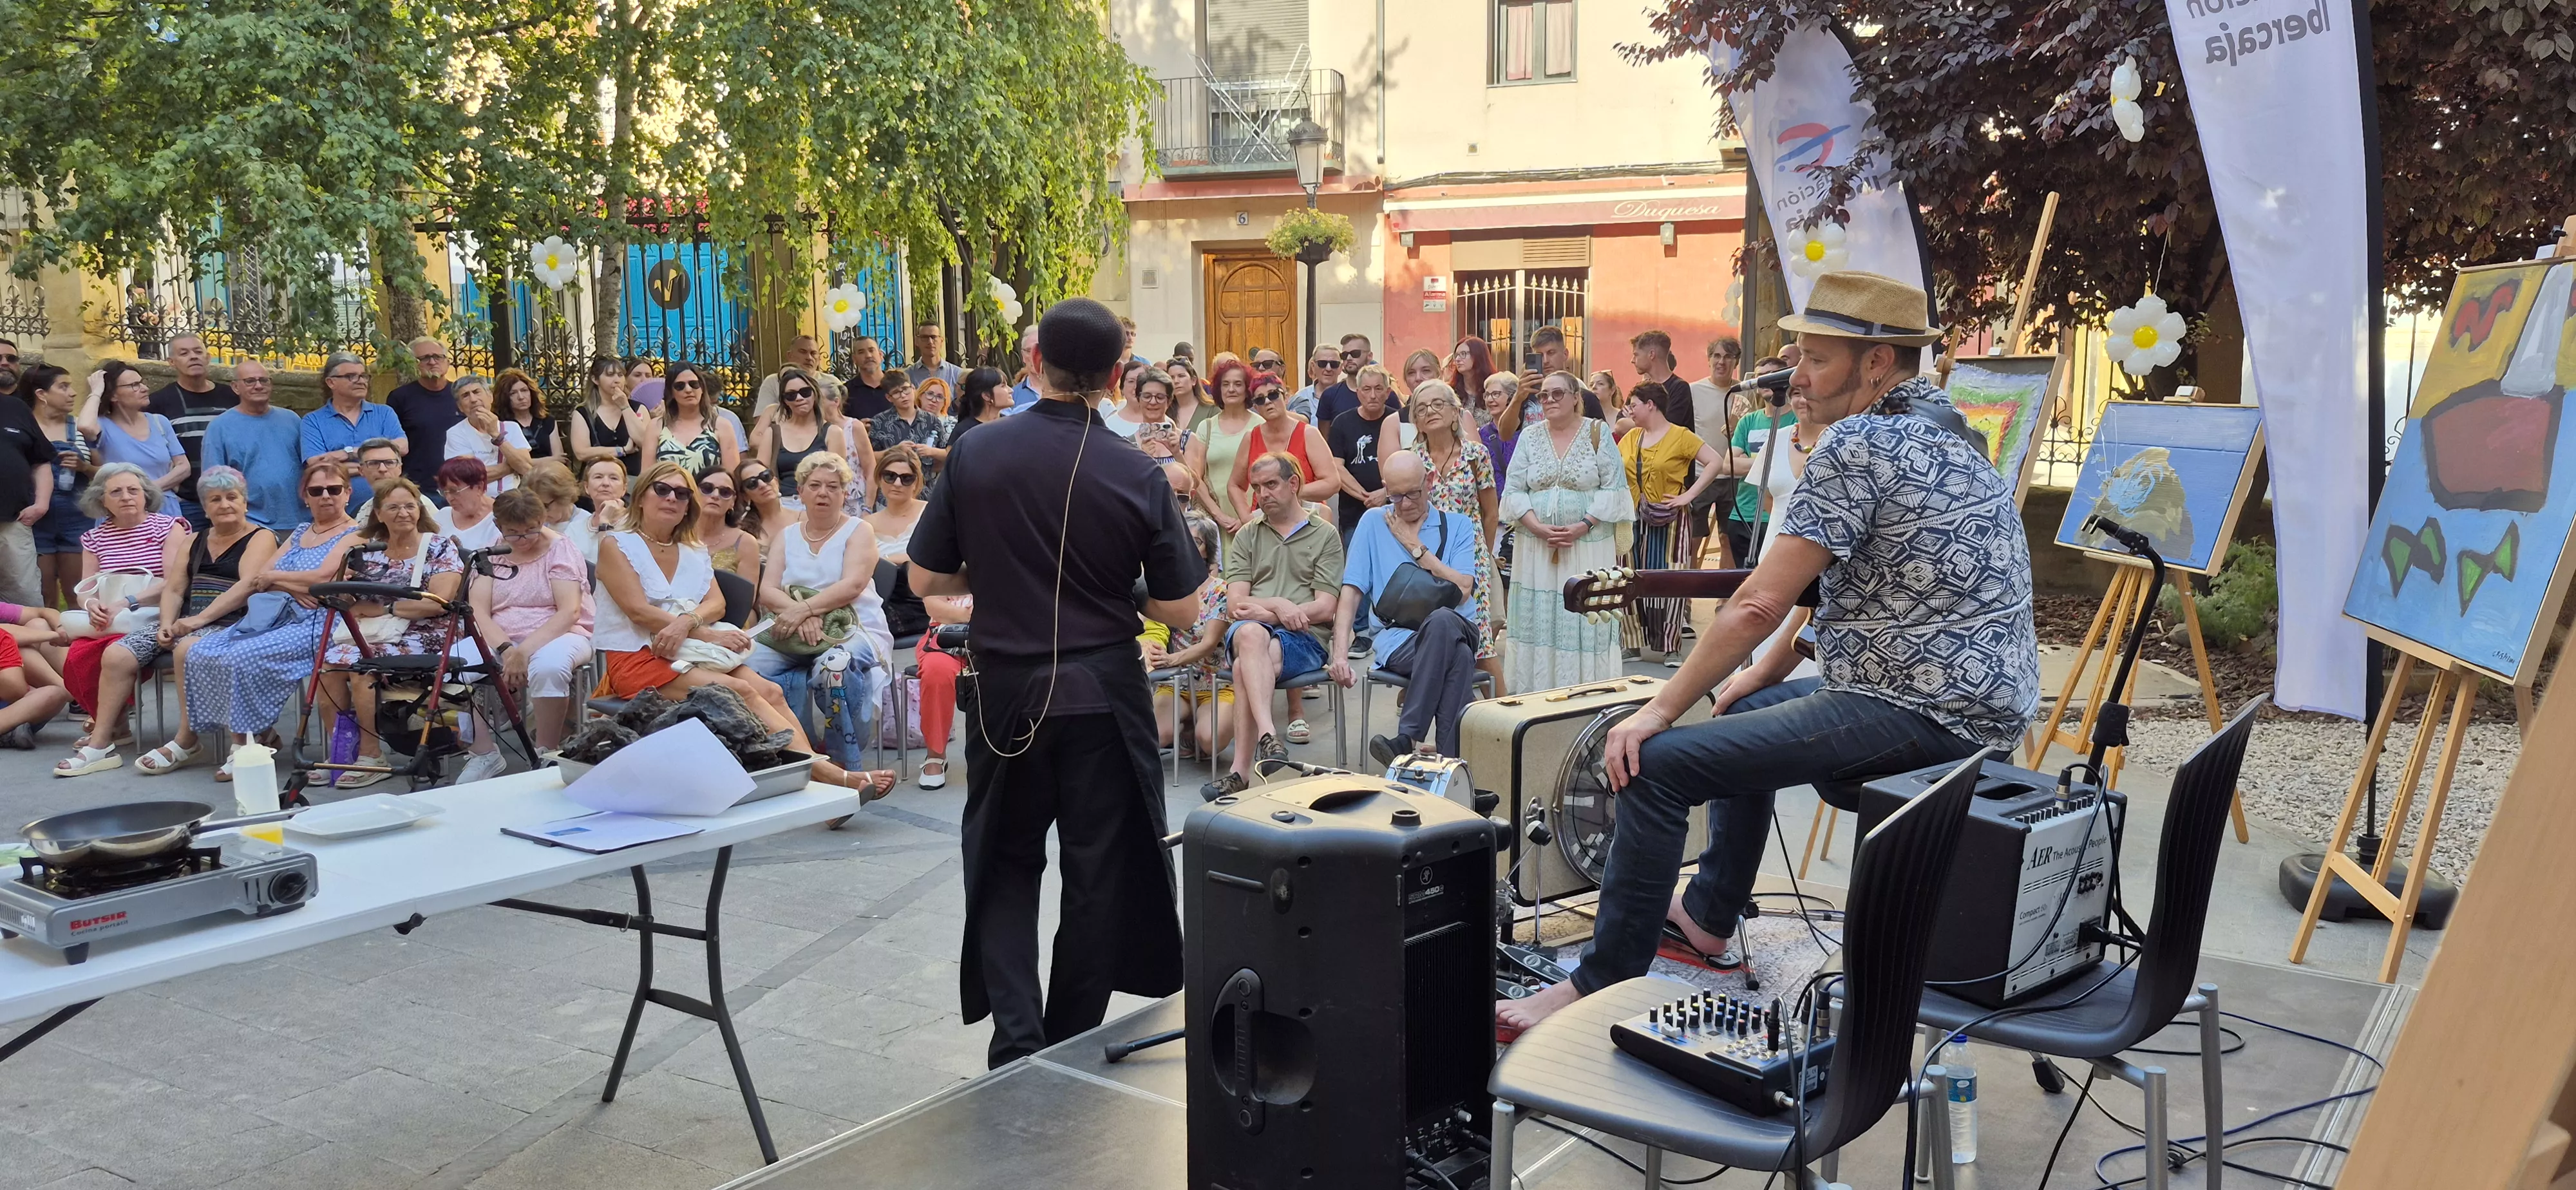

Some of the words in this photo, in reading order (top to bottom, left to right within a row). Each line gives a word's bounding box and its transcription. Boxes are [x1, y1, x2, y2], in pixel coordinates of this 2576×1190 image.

[1238, 212, 1246, 224] 6
[1611, 200, 1722, 221] Duquesa
[2027, 846, 2052, 871] AER
[2053, 850, 2063, 861] The
[2088, 836, 2107, 851] People
[71, 927, 97, 937] Cocina
